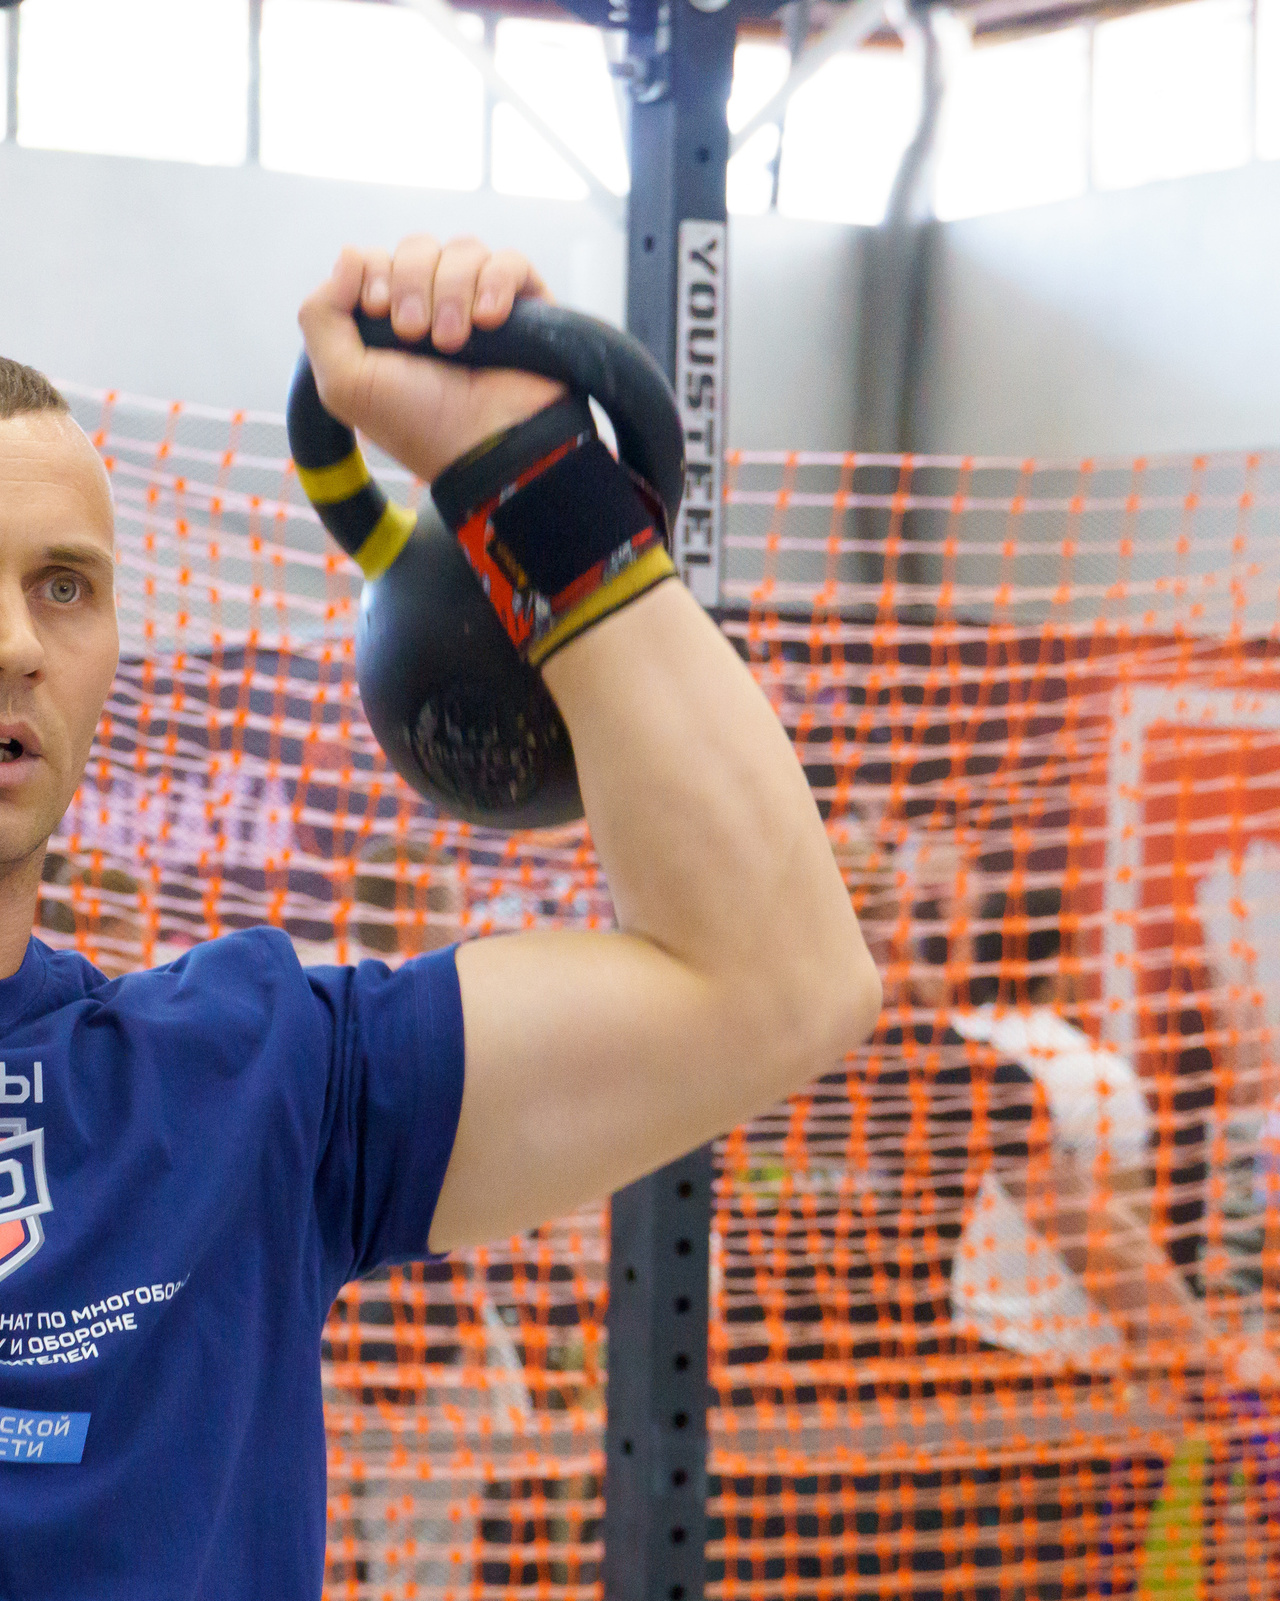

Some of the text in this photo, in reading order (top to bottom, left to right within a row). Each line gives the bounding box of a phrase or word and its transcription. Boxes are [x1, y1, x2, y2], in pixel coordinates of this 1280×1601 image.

[683, 238, 719, 591] YOUSTEEL
[10, 1338, 23, 1355] И
[28, 1312, 138, 1354] ОБОРОНЕ
[37, 1312, 66, 1330] ПО
